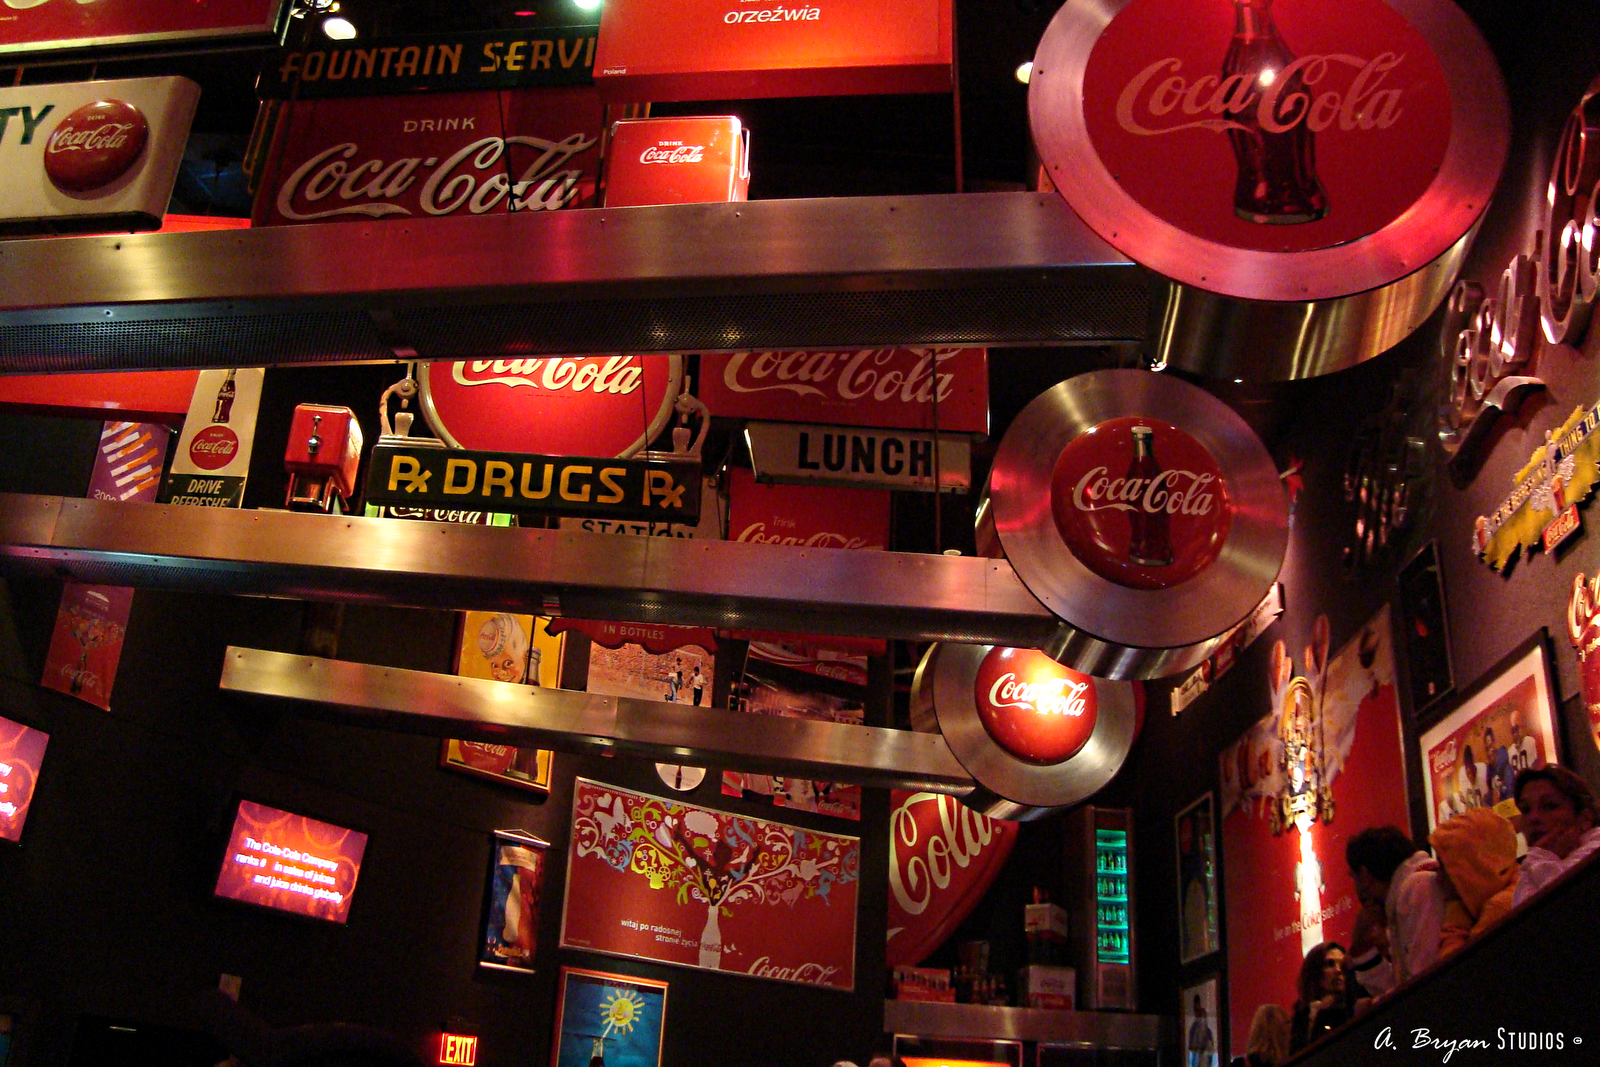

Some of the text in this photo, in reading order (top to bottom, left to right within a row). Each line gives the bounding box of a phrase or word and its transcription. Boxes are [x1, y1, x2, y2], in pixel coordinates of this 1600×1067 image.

[724, 5, 820, 24] orzeźwia
[279, 44, 463, 83] FOUNTAIN
[402, 117, 476, 133] DRINK
[49, 123, 134, 153] Coca-Cola
[640, 146, 706, 164] Coca-Cola
[277, 133, 599, 220] Coca-Cola
[452, 357, 643, 395] CocaCola
[798, 433, 933, 478] LUNCH
[187, 479, 225, 494] DRIVE
[443, 458, 627, 505] DRUGS
[1073, 466, 1215, 516] Coca-Cola
[604, 625, 665, 640] IN BOTTLES
[989, 673, 1089, 717] CocaCola
[245, 837, 262, 851] The
[253, 874, 271, 886] and
[289, 881, 314, 896] drinks
[621, 919, 682, 938] witaj po radosnej
[655, 934, 680, 944] stronie
[446, 1036, 473, 1063] EXIT
